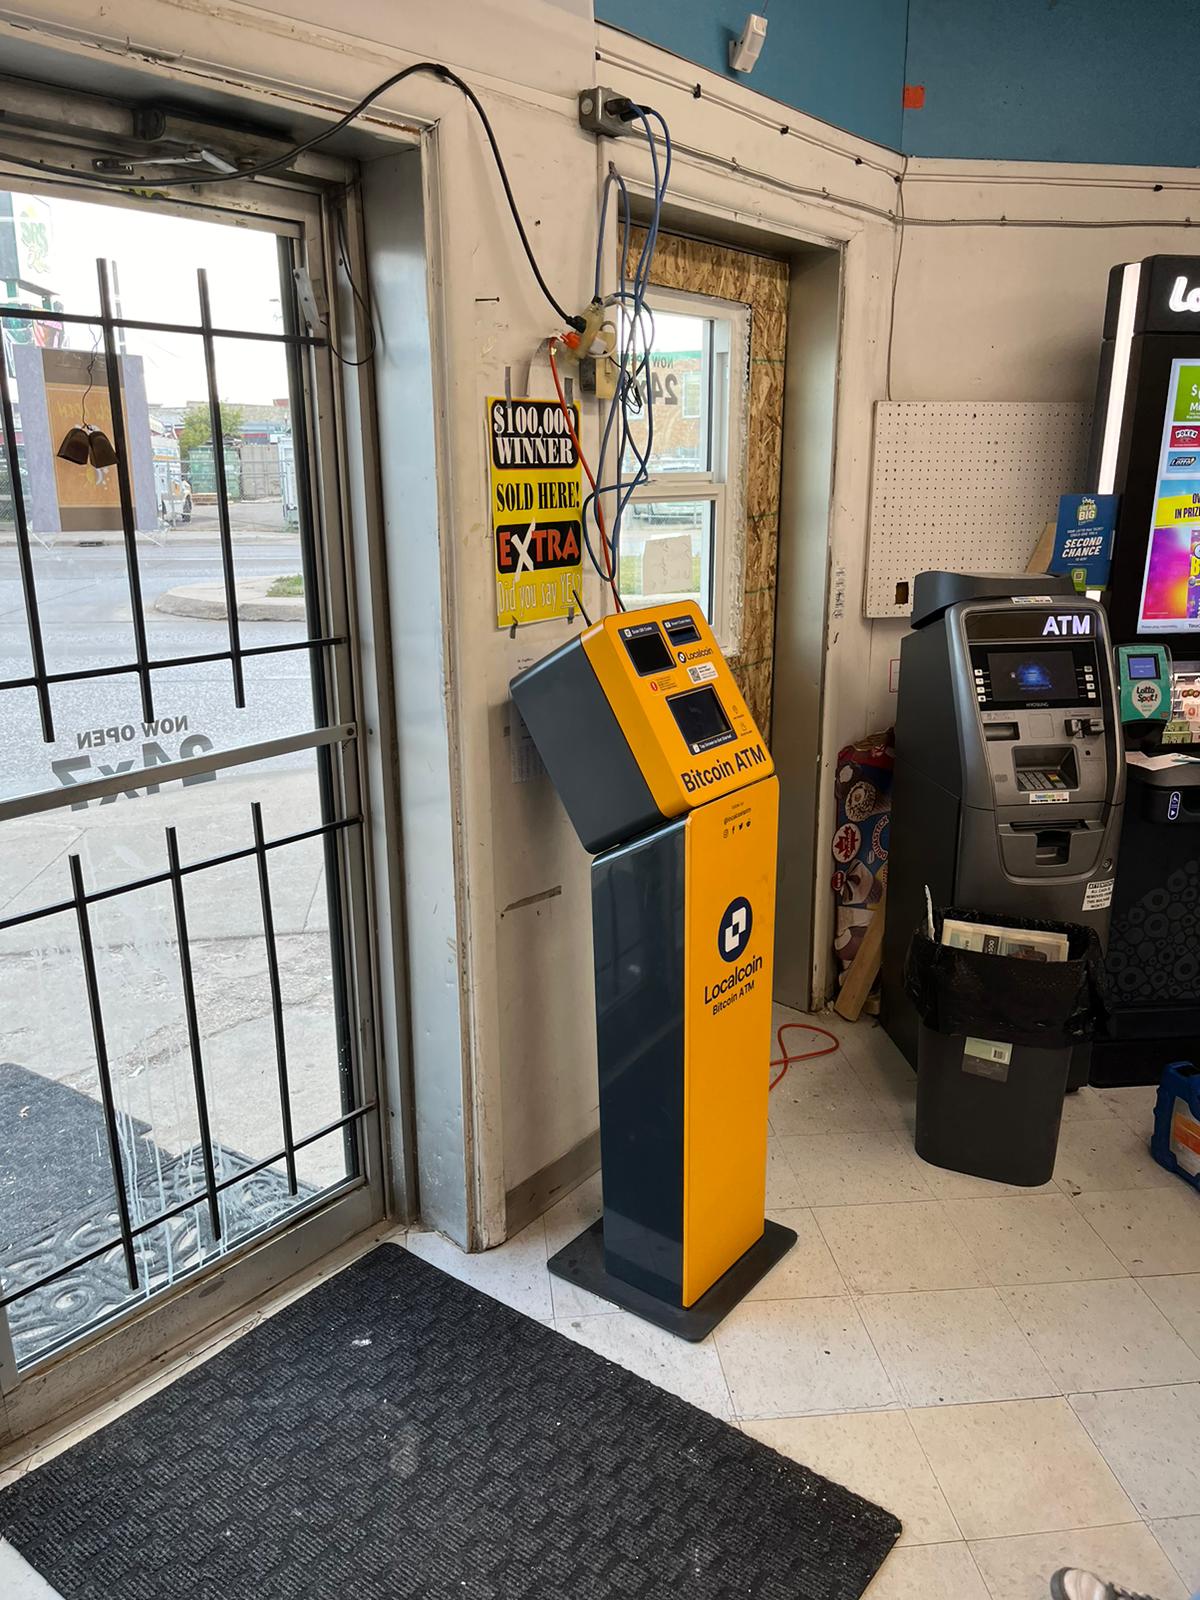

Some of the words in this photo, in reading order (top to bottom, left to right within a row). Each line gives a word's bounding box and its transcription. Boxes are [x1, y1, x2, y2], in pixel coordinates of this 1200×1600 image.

[493, 404, 576, 438] $100,000
[496, 437, 574, 465] WINNER
[497, 482, 533, 512] SOLD
[538, 481, 580, 511] HERE!
[1079, 511, 1096, 521] BIG
[1175, 508, 1182, 519] IN
[499, 519, 580, 581] EXTRA
[1062, 545, 1102, 558] CHANCE
[1064, 536, 1103, 549] SECOND
[496, 579, 516, 616] Did
[519, 585, 537, 617] you
[542, 582, 557, 612] say
[1042, 615, 1090, 636] ATM
[1136, 686, 1155, 694] Lotto
[681, 759, 735, 793] Bitcoin
[734, 744, 767, 772] ATM
[704, 955, 763, 1004] Localcoin
[712, 993, 738, 1015] Bitcoin
[739, 979, 755, 999] ATM
